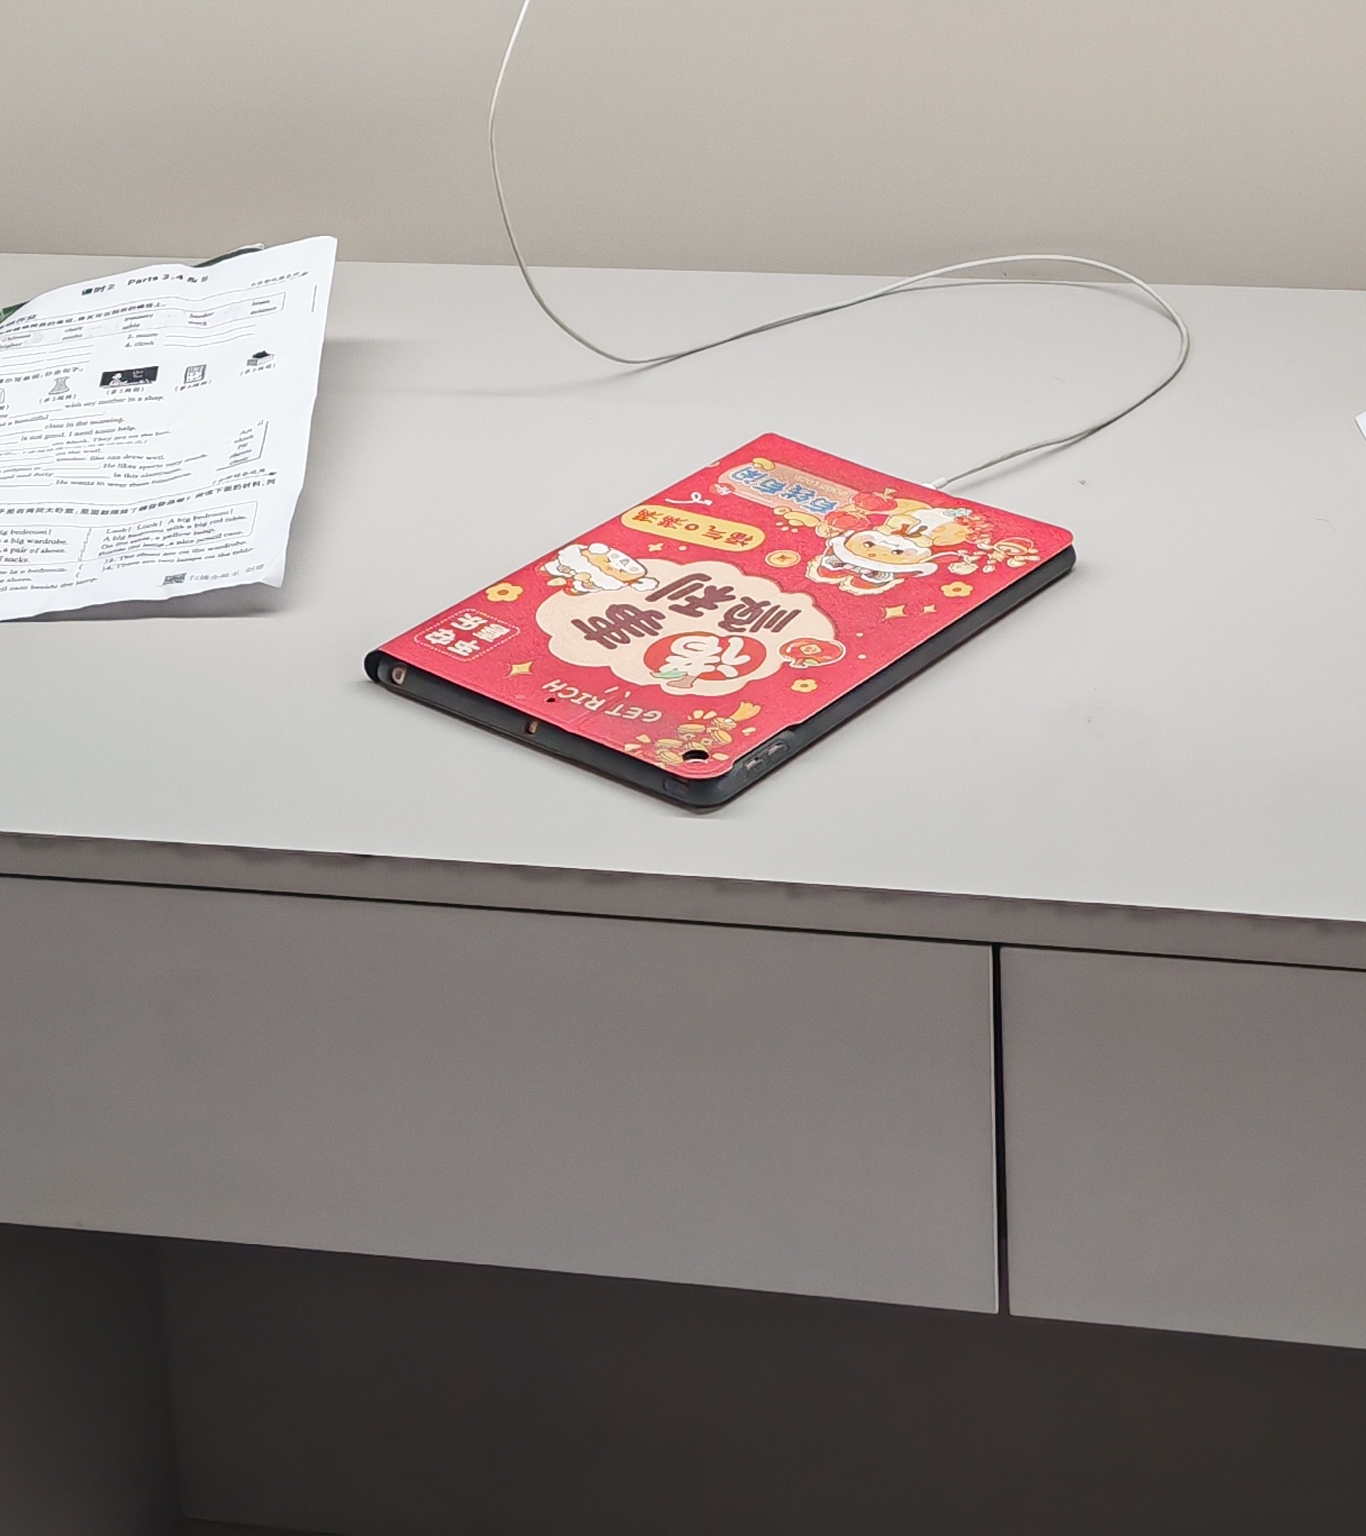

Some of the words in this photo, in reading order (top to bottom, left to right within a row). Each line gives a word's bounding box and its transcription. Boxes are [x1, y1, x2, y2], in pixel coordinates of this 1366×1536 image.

[127, 275, 160, 287] Parts
[643, 572, 797, 634] 顺利
[450, 611, 512, 640] 喜乐
[425, 627, 481, 658] 平安
[541, 677, 606, 713] RICH
[603, 695, 664, 724] GET
